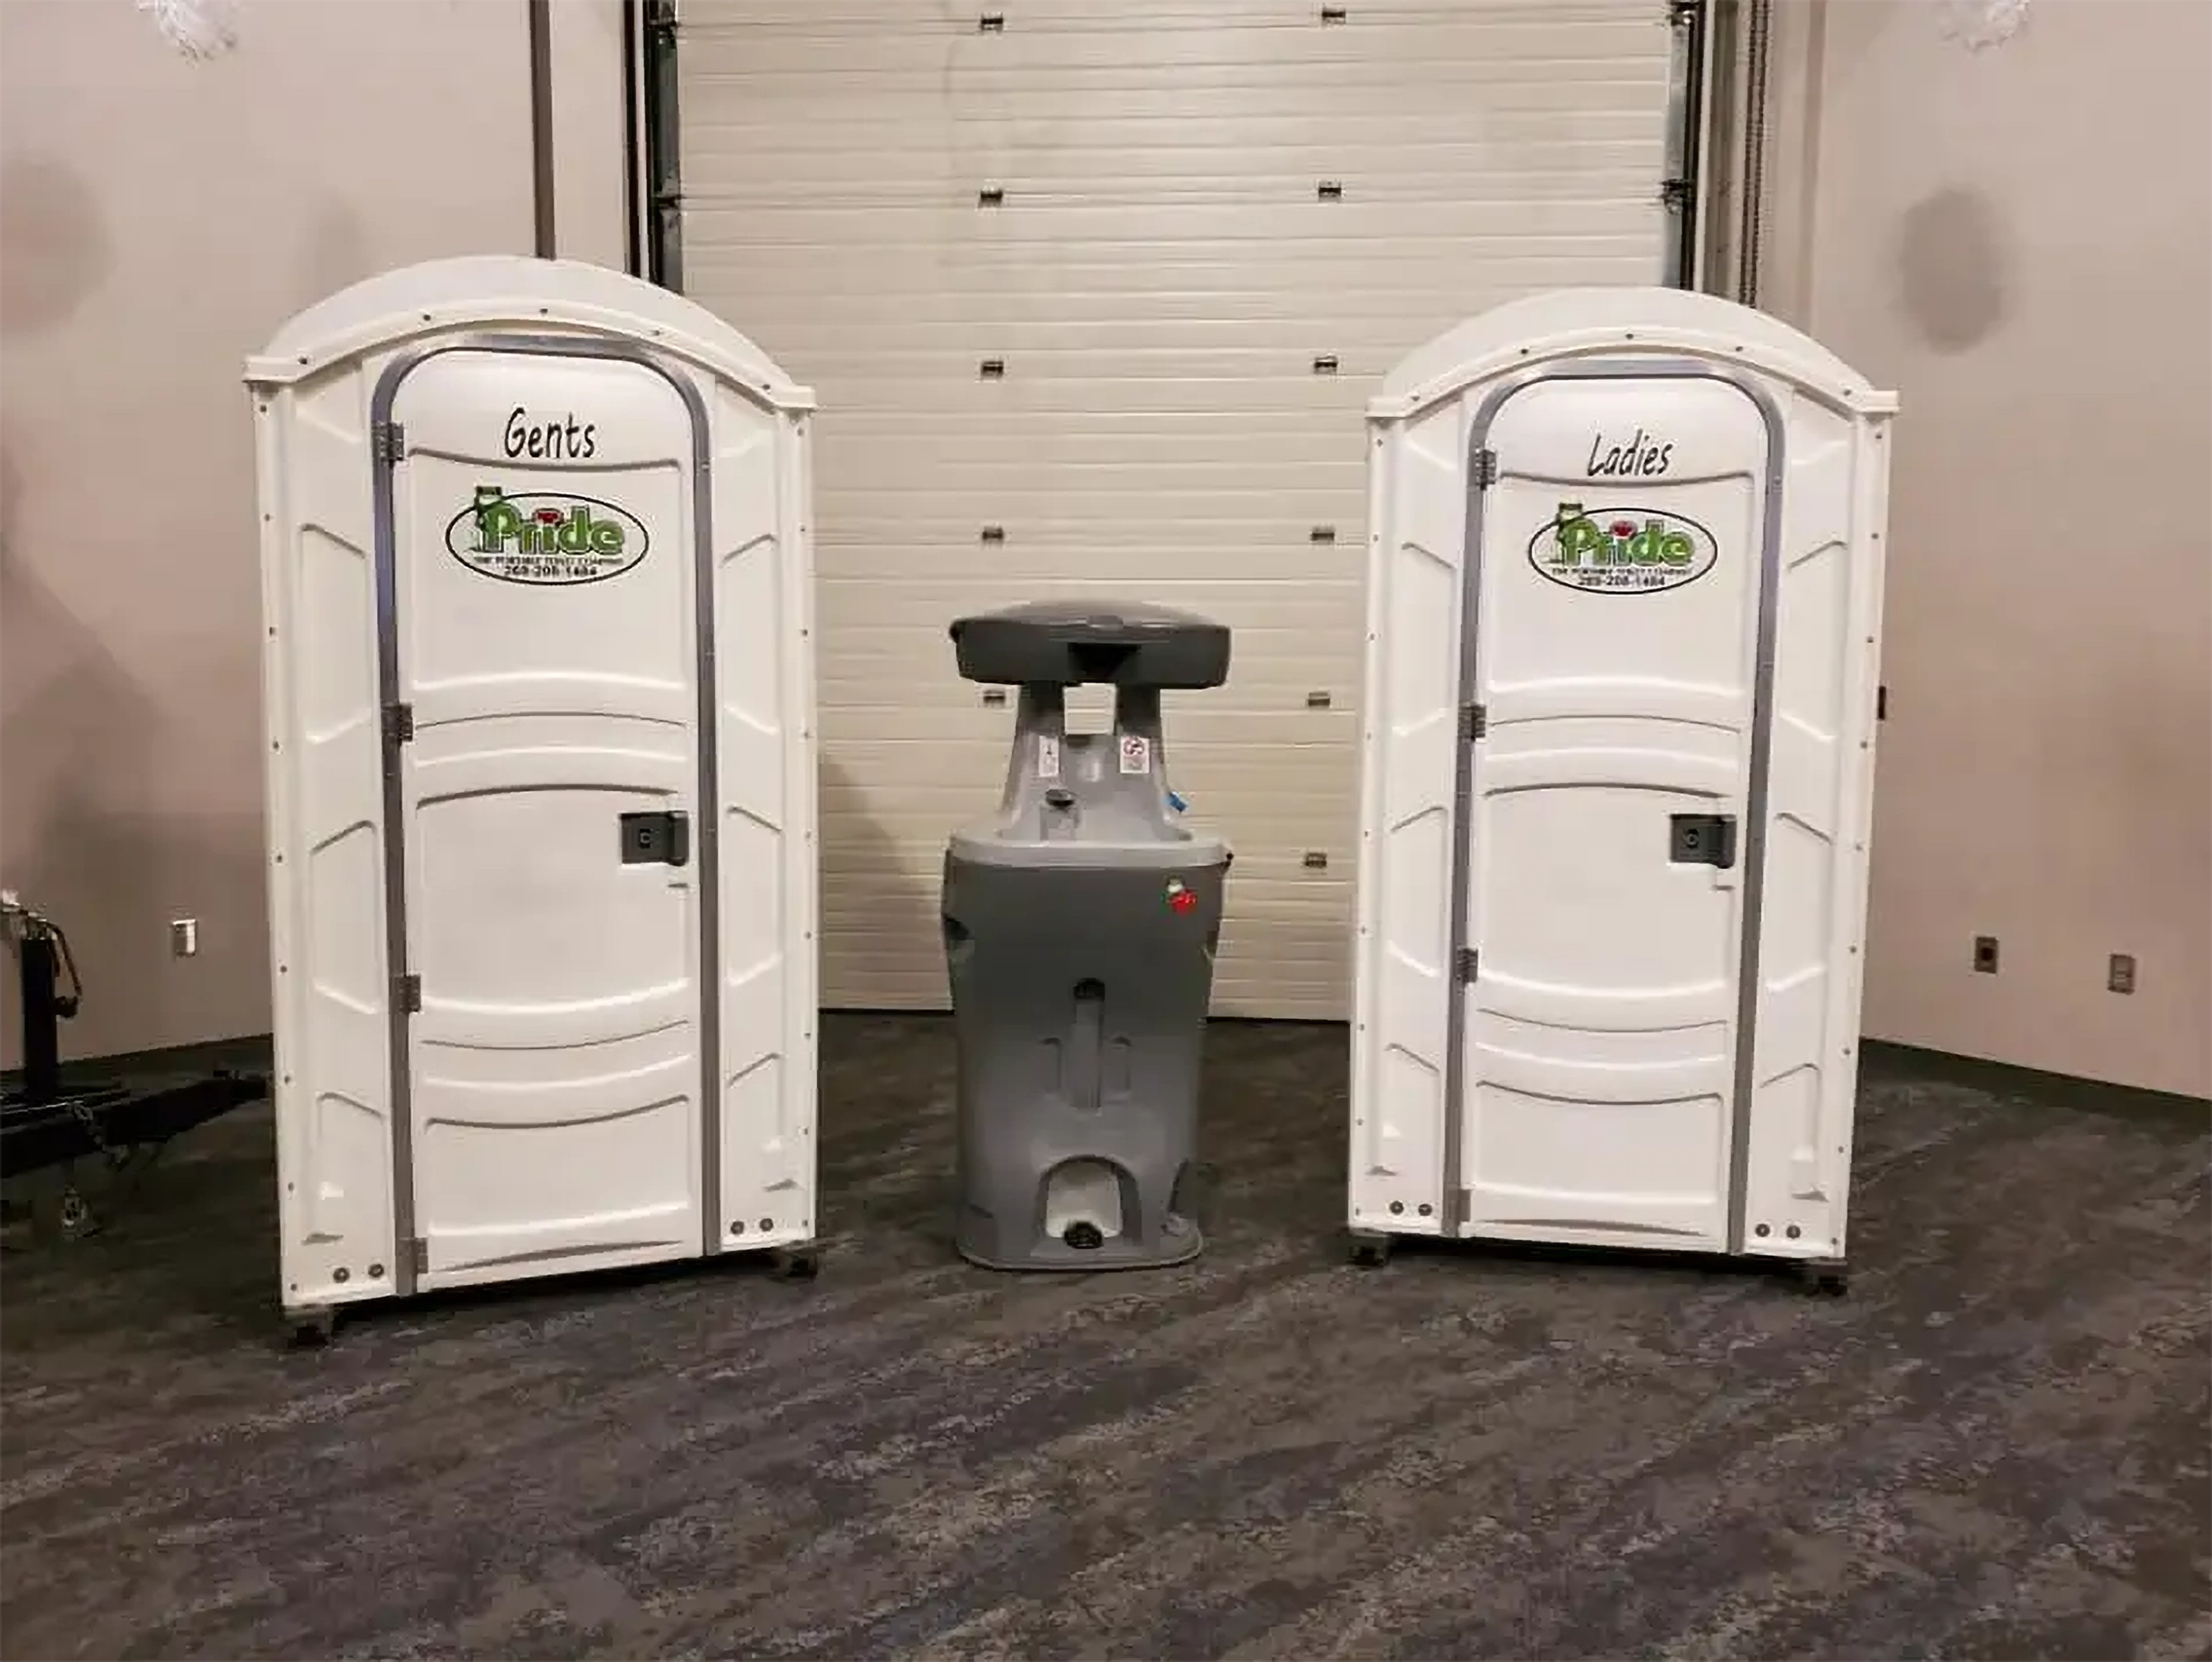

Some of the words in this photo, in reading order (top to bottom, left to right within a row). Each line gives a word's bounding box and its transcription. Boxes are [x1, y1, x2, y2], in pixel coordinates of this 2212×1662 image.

[504, 407, 596, 458] Gents
[1587, 429, 1673, 476] Ladies
[478, 503, 625, 555] Pride
[1561, 517, 1695, 566] Pride
